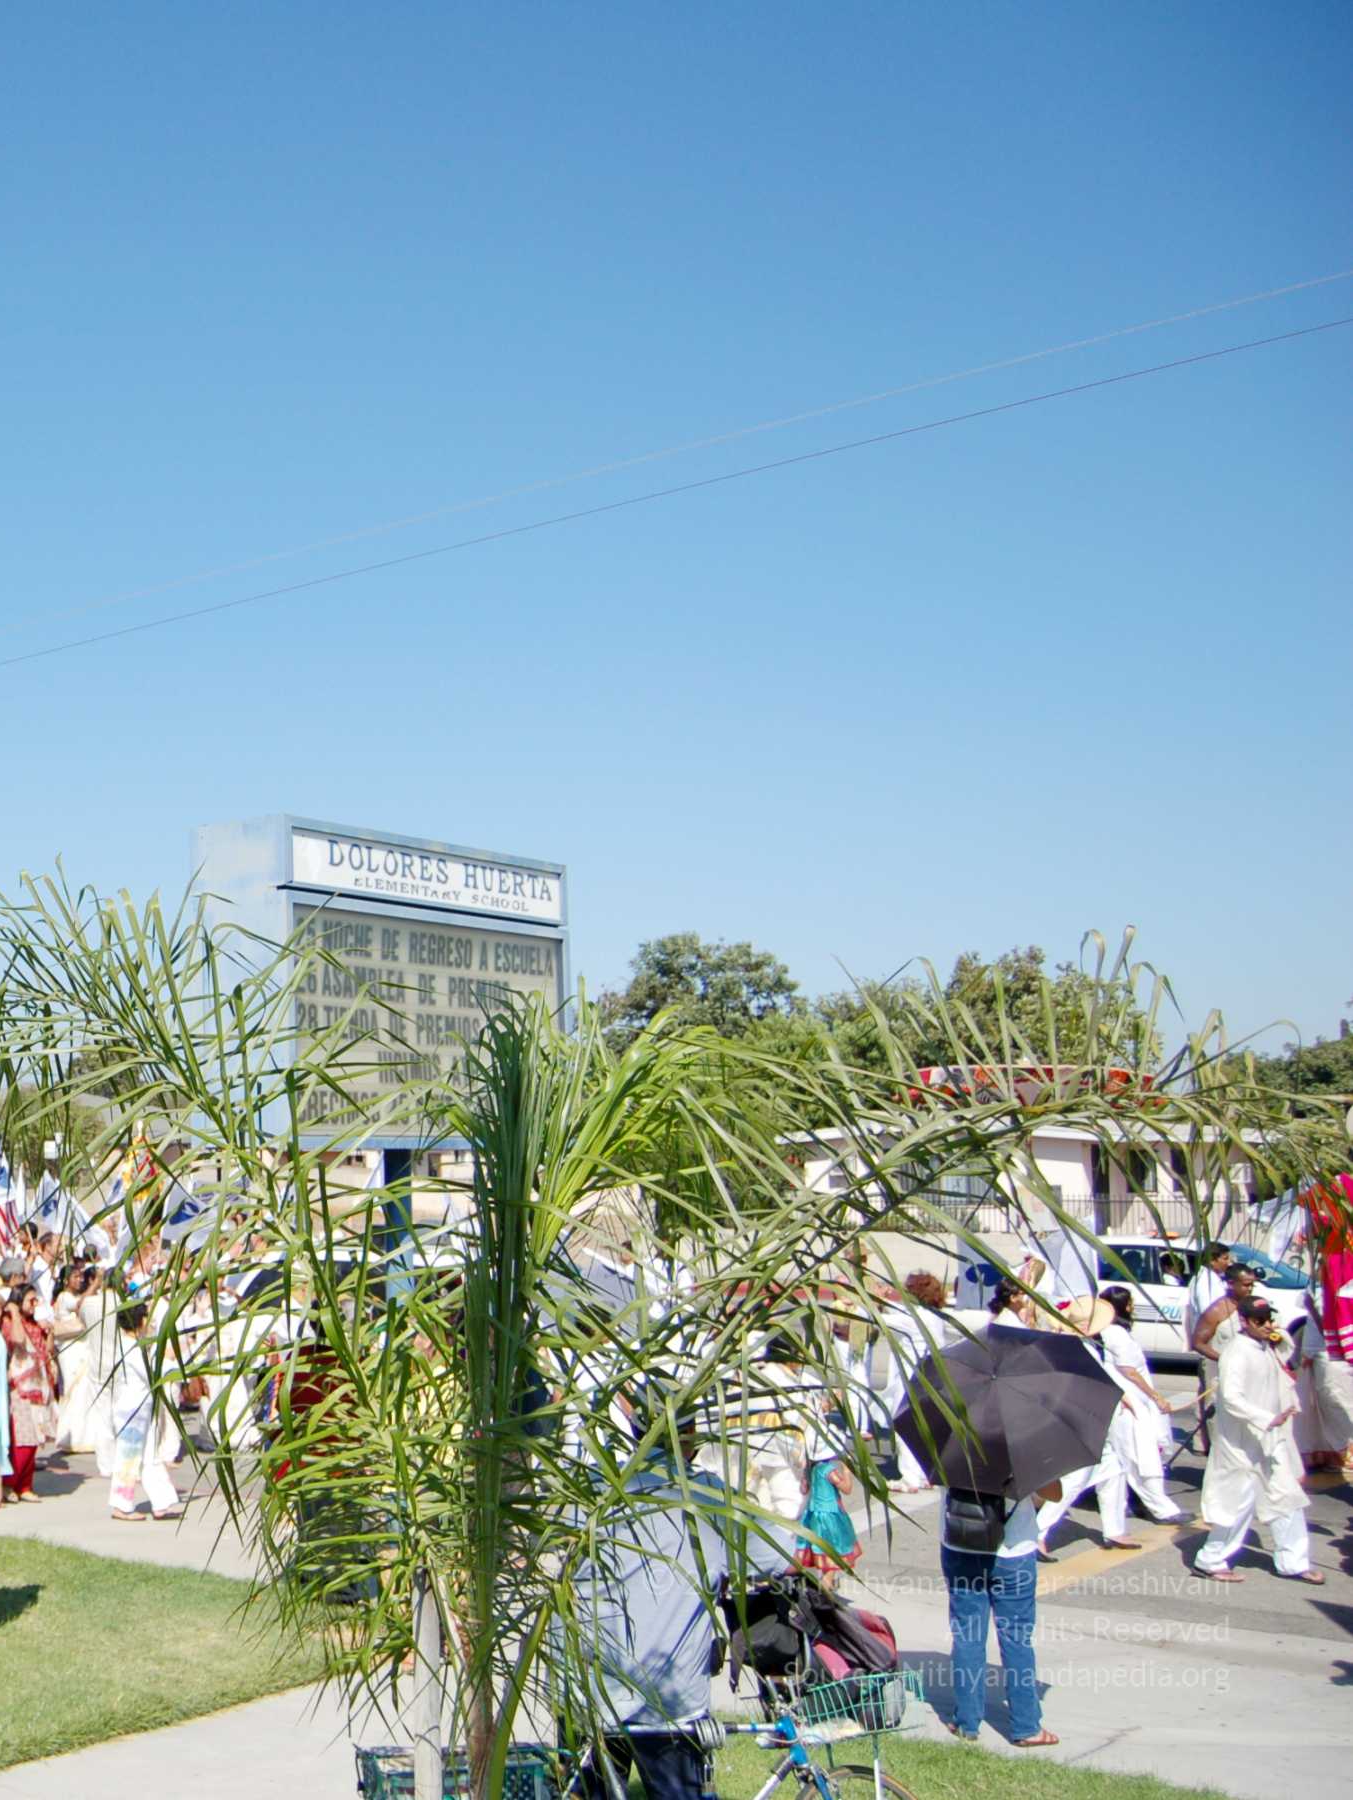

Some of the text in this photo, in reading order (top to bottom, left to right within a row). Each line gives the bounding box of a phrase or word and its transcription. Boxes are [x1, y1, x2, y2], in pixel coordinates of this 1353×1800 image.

[328, 839, 553, 902] DOLORES HUERTA
[353, 877, 530, 913] ELEMENTARY SCHOOL
[323, 919, 373, 957] NOCHE
[381, 927, 400, 961] DE
[409, 930, 472, 970] REGRESO
[479, 940, 488, 971] A
[494, 941, 553, 977] ESCUELA
[322, 963, 406, 1004] ASAMBLEA
[418, 973, 436, 1006] DE
[297, 1001, 319, 1032] 28
[389, 1011, 408, 1044] DE
[416, 1013, 482, 1050] PREMIOS
